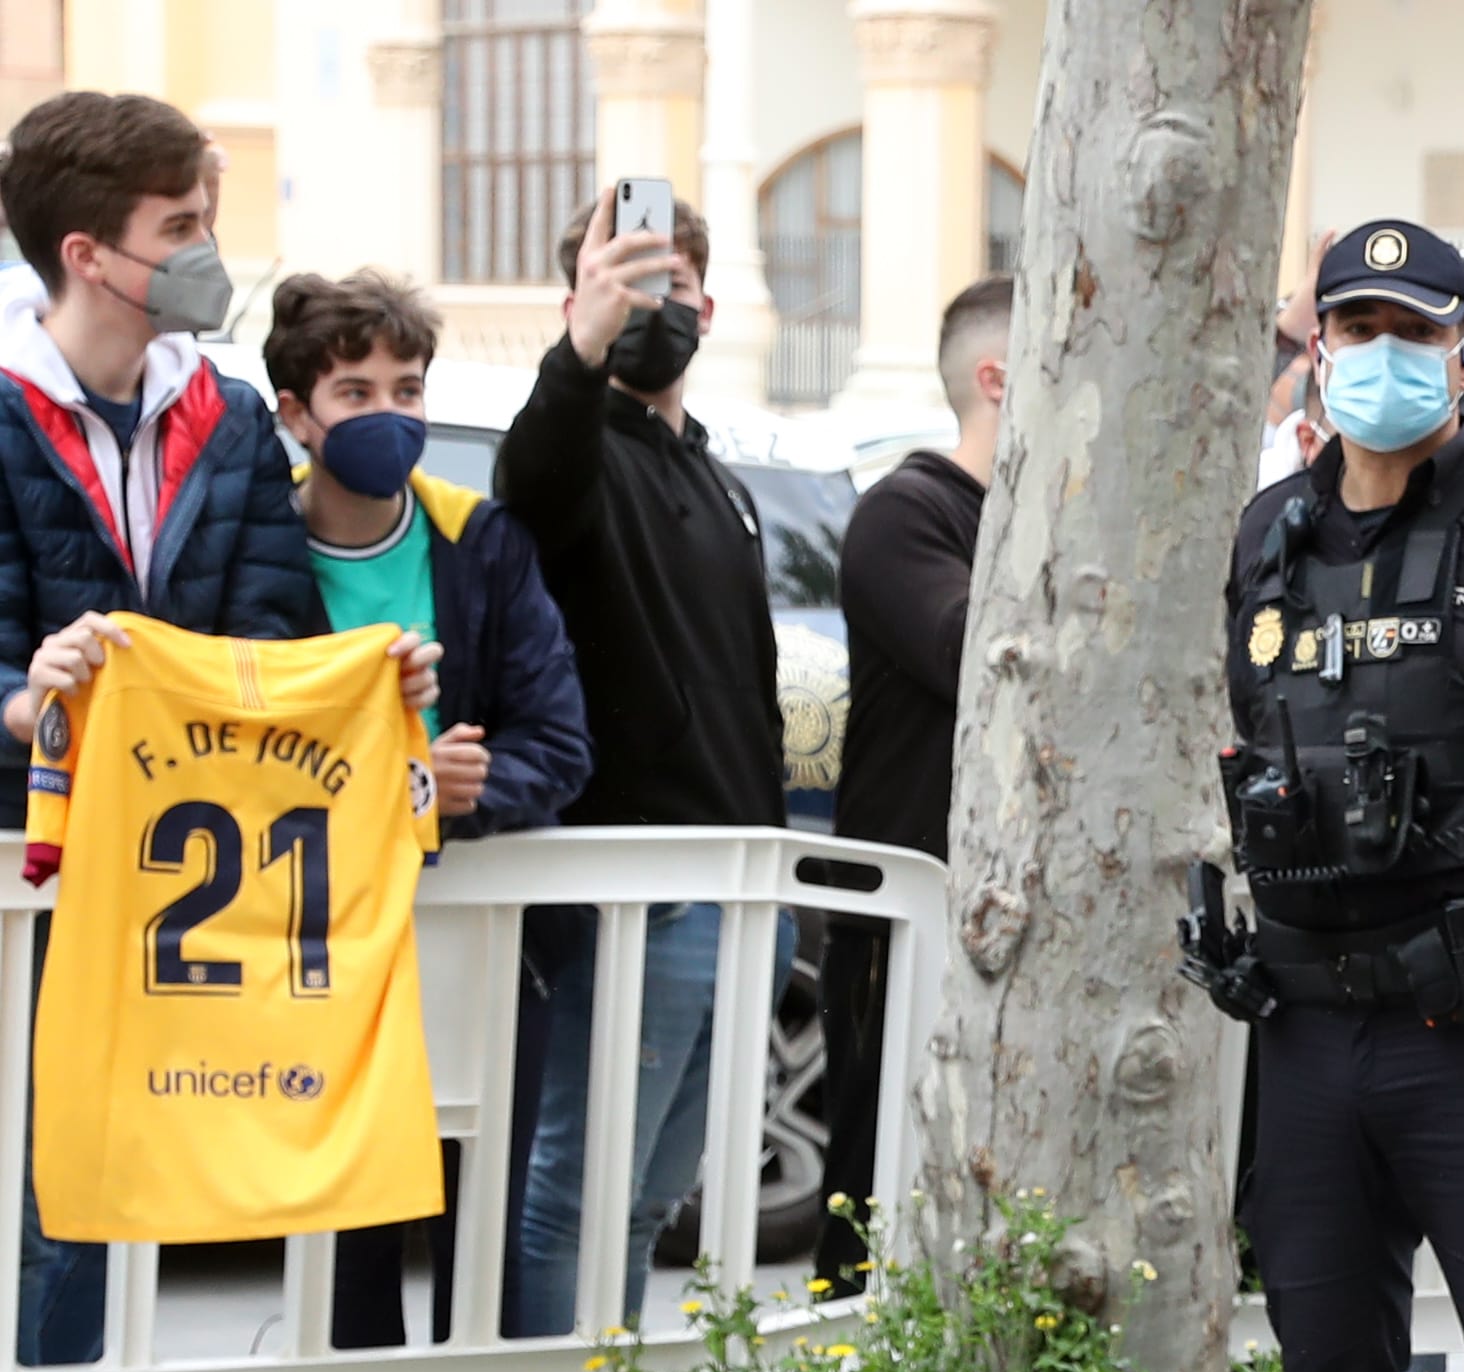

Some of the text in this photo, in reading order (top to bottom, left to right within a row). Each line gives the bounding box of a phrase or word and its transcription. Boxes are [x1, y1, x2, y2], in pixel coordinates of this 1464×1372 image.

[131, 720, 352, 797] F. DE JONG
[139, 800, 331, 997] 21
[147, 1060, 272, 1098] unicef
